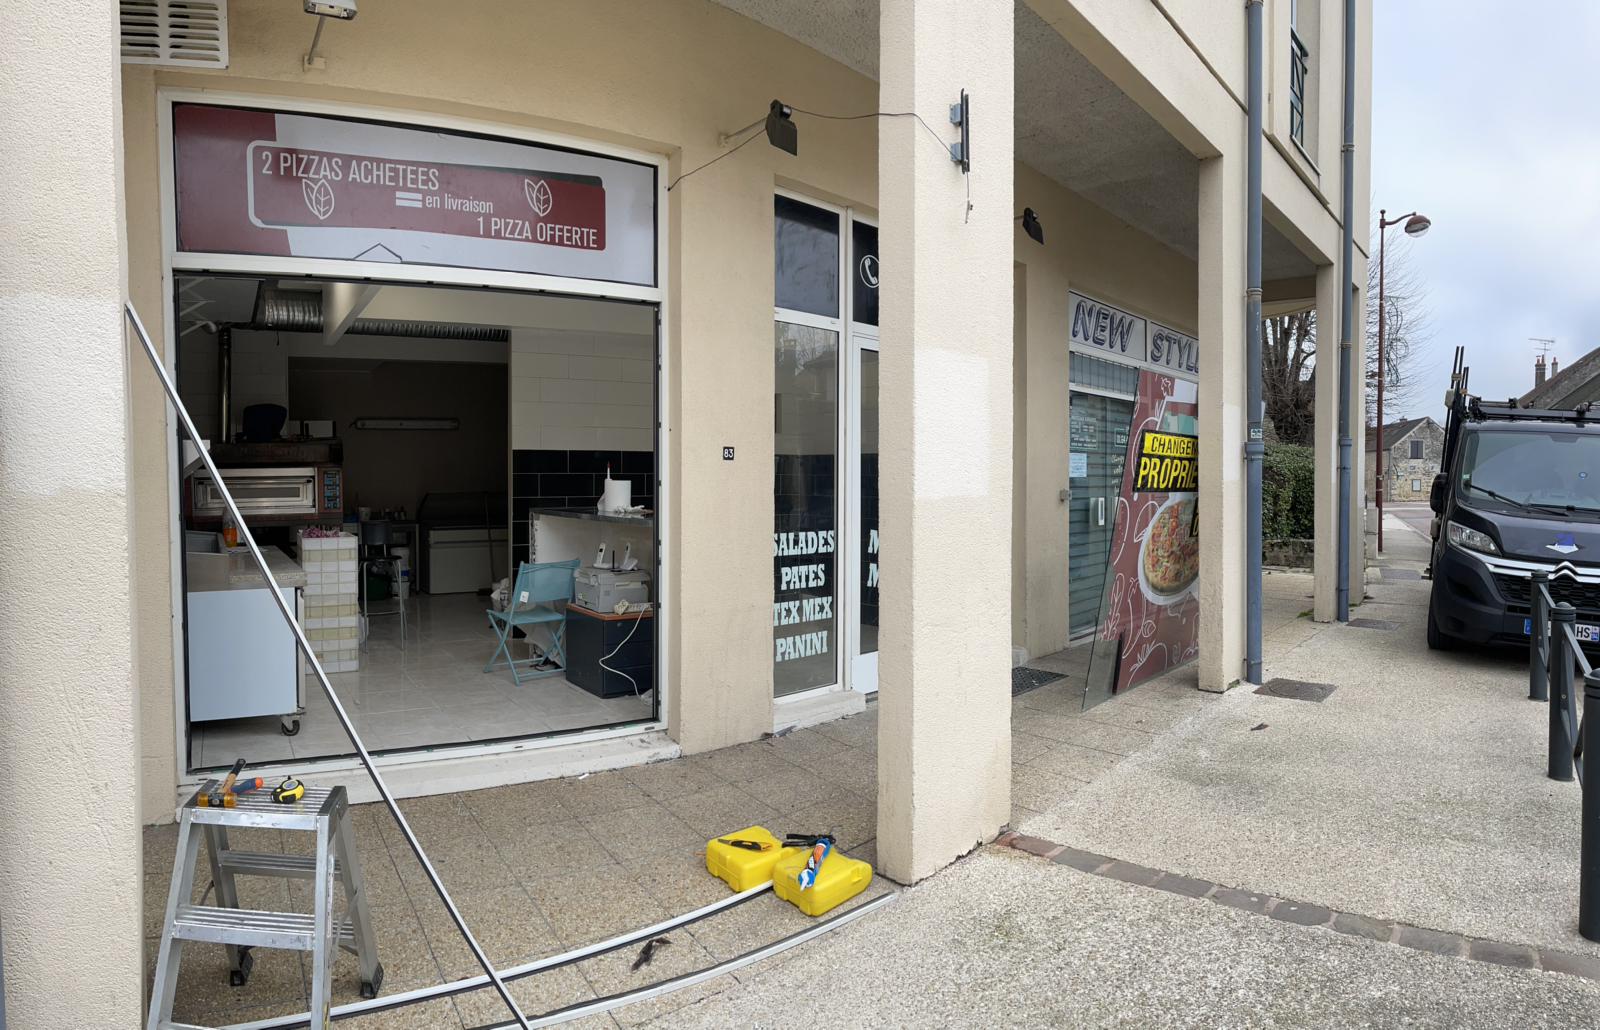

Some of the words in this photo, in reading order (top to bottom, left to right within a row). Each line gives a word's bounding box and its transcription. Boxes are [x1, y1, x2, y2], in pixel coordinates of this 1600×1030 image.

[262, 151, 272, 175] 2
[279, 152, 342, 181] PIZZAS
[348, 160, 439, 190] ACHETEES
[425, 195, 440, 209] en
[444, 193, 494, 214] livraison
[477, 216, 484, 236] 1
[491, 217, 532, 240] PIZZA
[537, 222, 598, 248] OFFERTE
[1072, 300, 1134, 352] NEW
[724, 448, 734, 458] 83
[781, 563, 825, 591] PATES
[773, 600, 800, 627] TEX
[802, 595, 833, 622] MEX
[775, 630, 828, 662] PANINI
